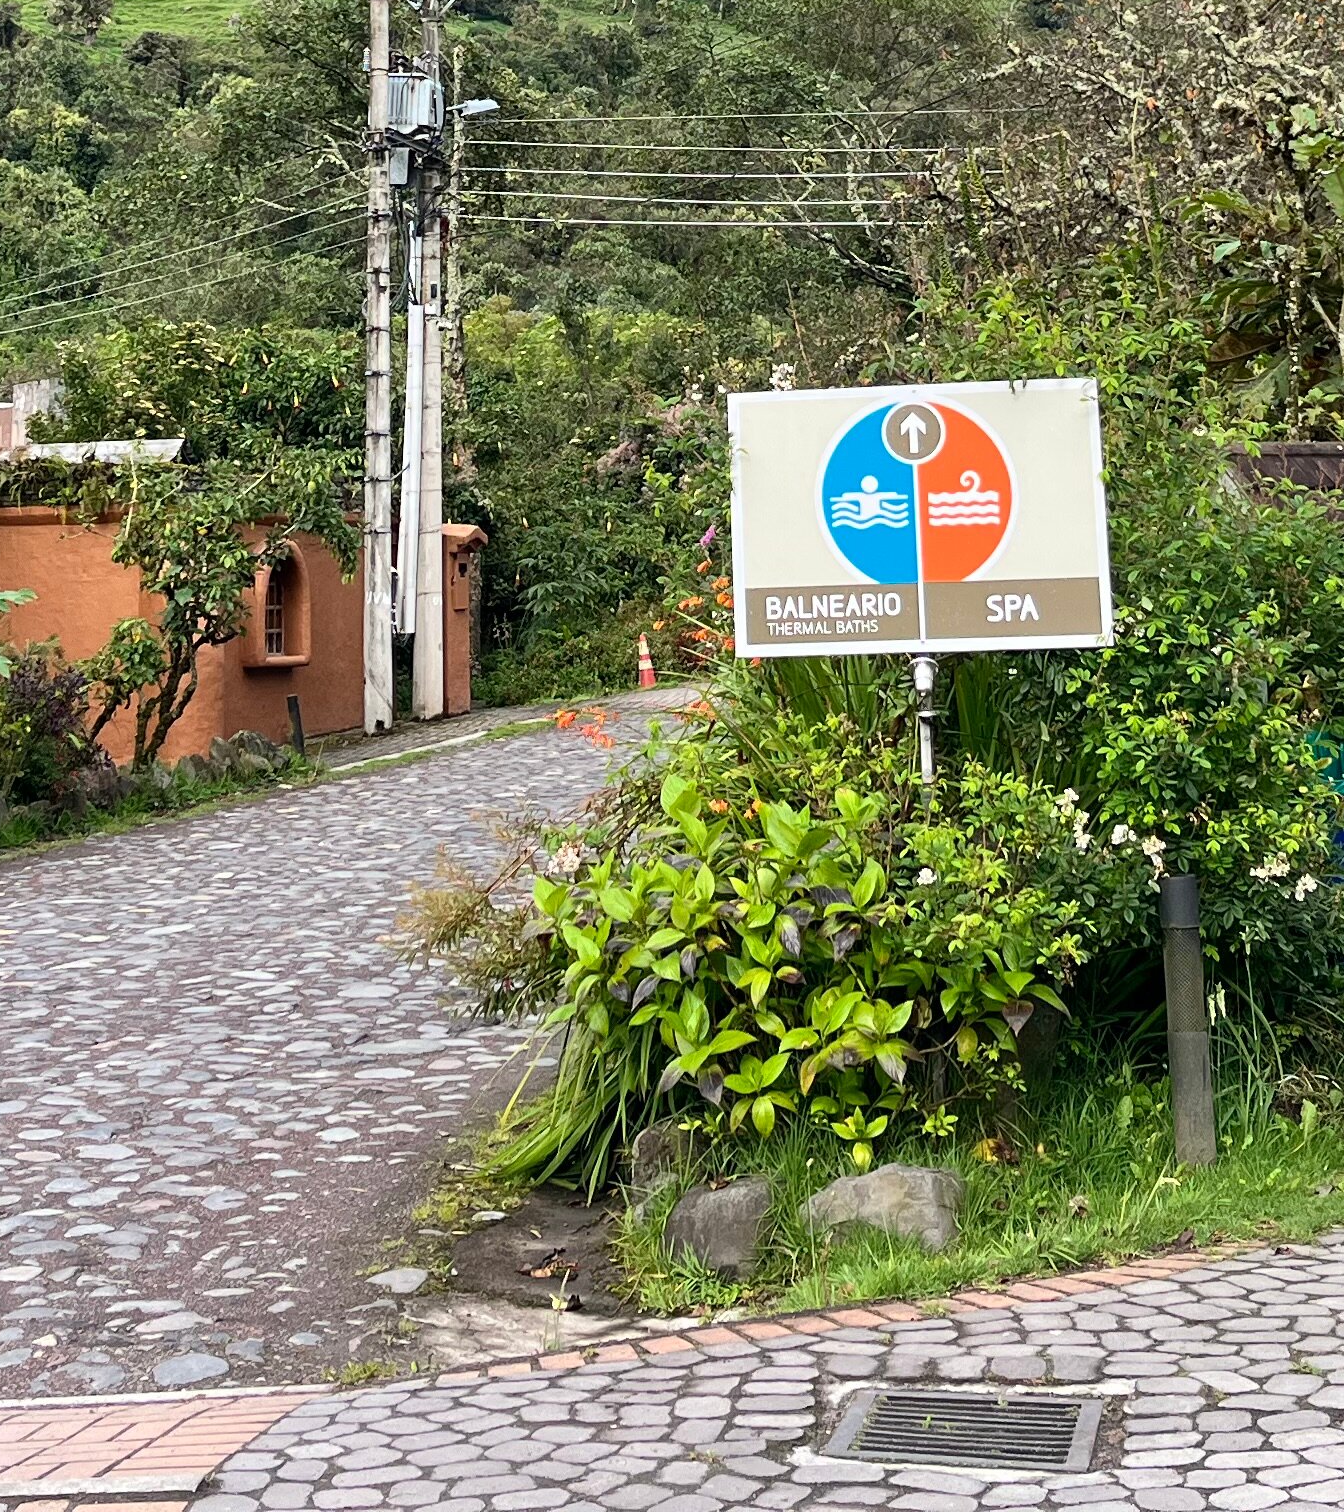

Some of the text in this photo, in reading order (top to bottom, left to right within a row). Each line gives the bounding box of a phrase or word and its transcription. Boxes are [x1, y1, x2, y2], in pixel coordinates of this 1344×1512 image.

[765, 592, 901, 620] BALNEARIO
[985, 594, 1040, 622] SPA
[766, 620, 879, 636] THERMAL BATHS
